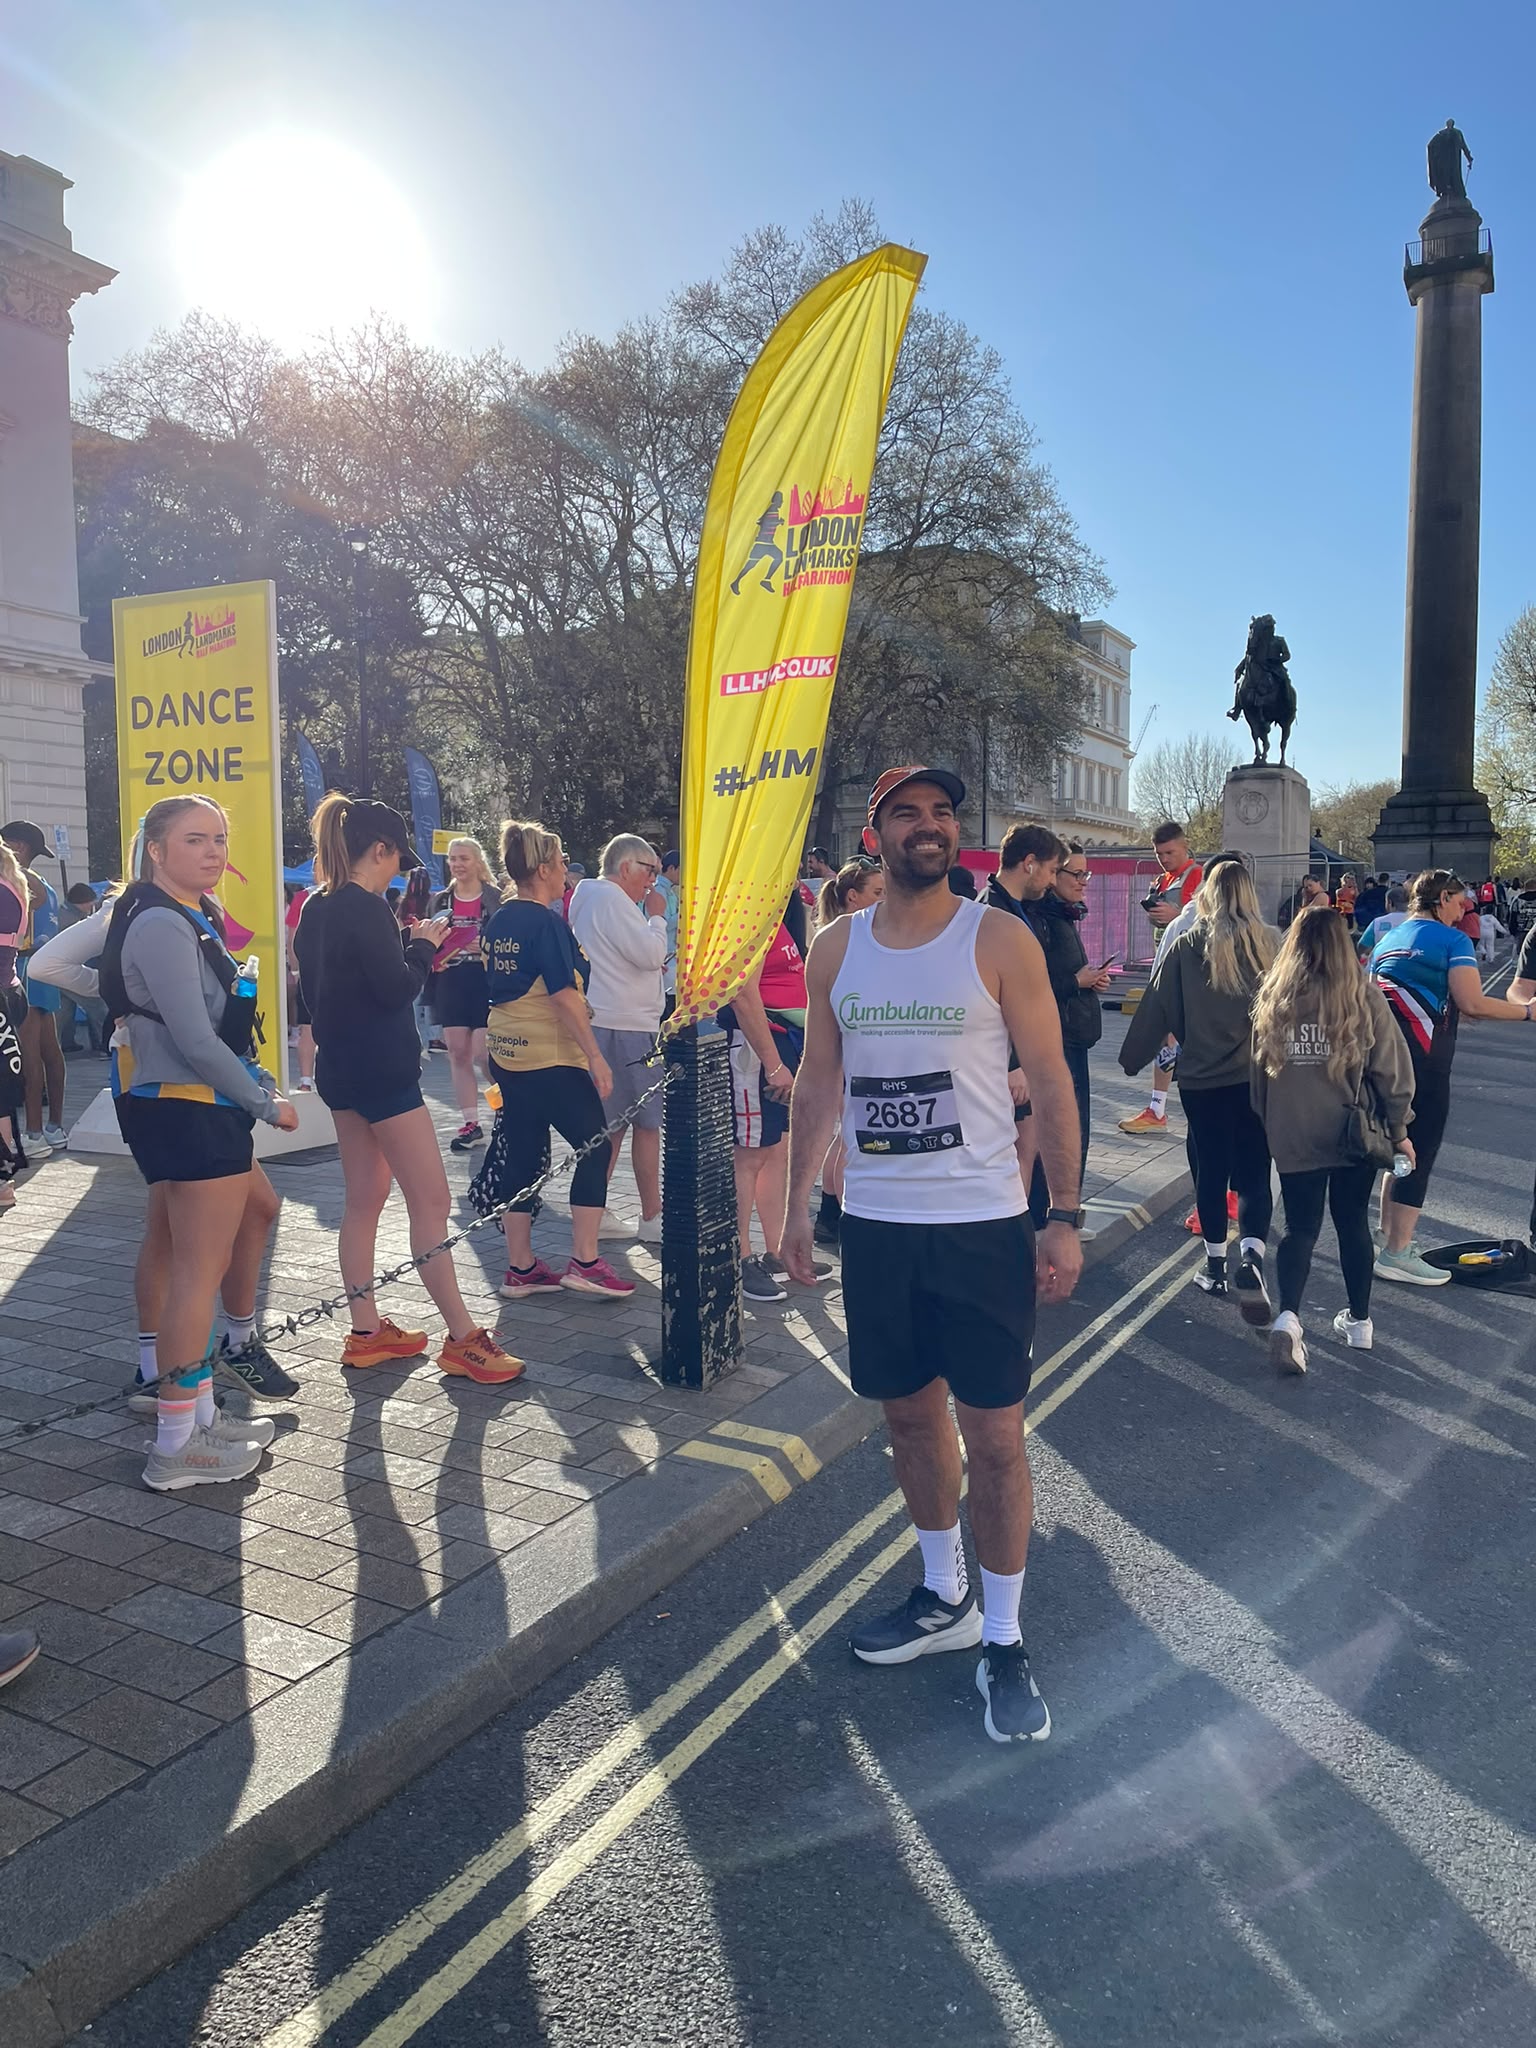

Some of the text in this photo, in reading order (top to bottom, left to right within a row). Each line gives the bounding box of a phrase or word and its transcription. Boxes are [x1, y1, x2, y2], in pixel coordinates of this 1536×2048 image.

[803, 569, 852, 586] ARATHON
[142, 624, 237, 657] LONDON LANDMARKS
[131, 686, 255, 729] DANCE
[144, 747, 244, 785] ZONE
[845, 998, 966, 1022] Jumbulance
[882, 1081, 908, 1091] RHYS
[865, 1097, 937, 1129] 2687
[463, 1350, 487, 1366] HOKA
[184, 1454, 221, 1468] HOKA
